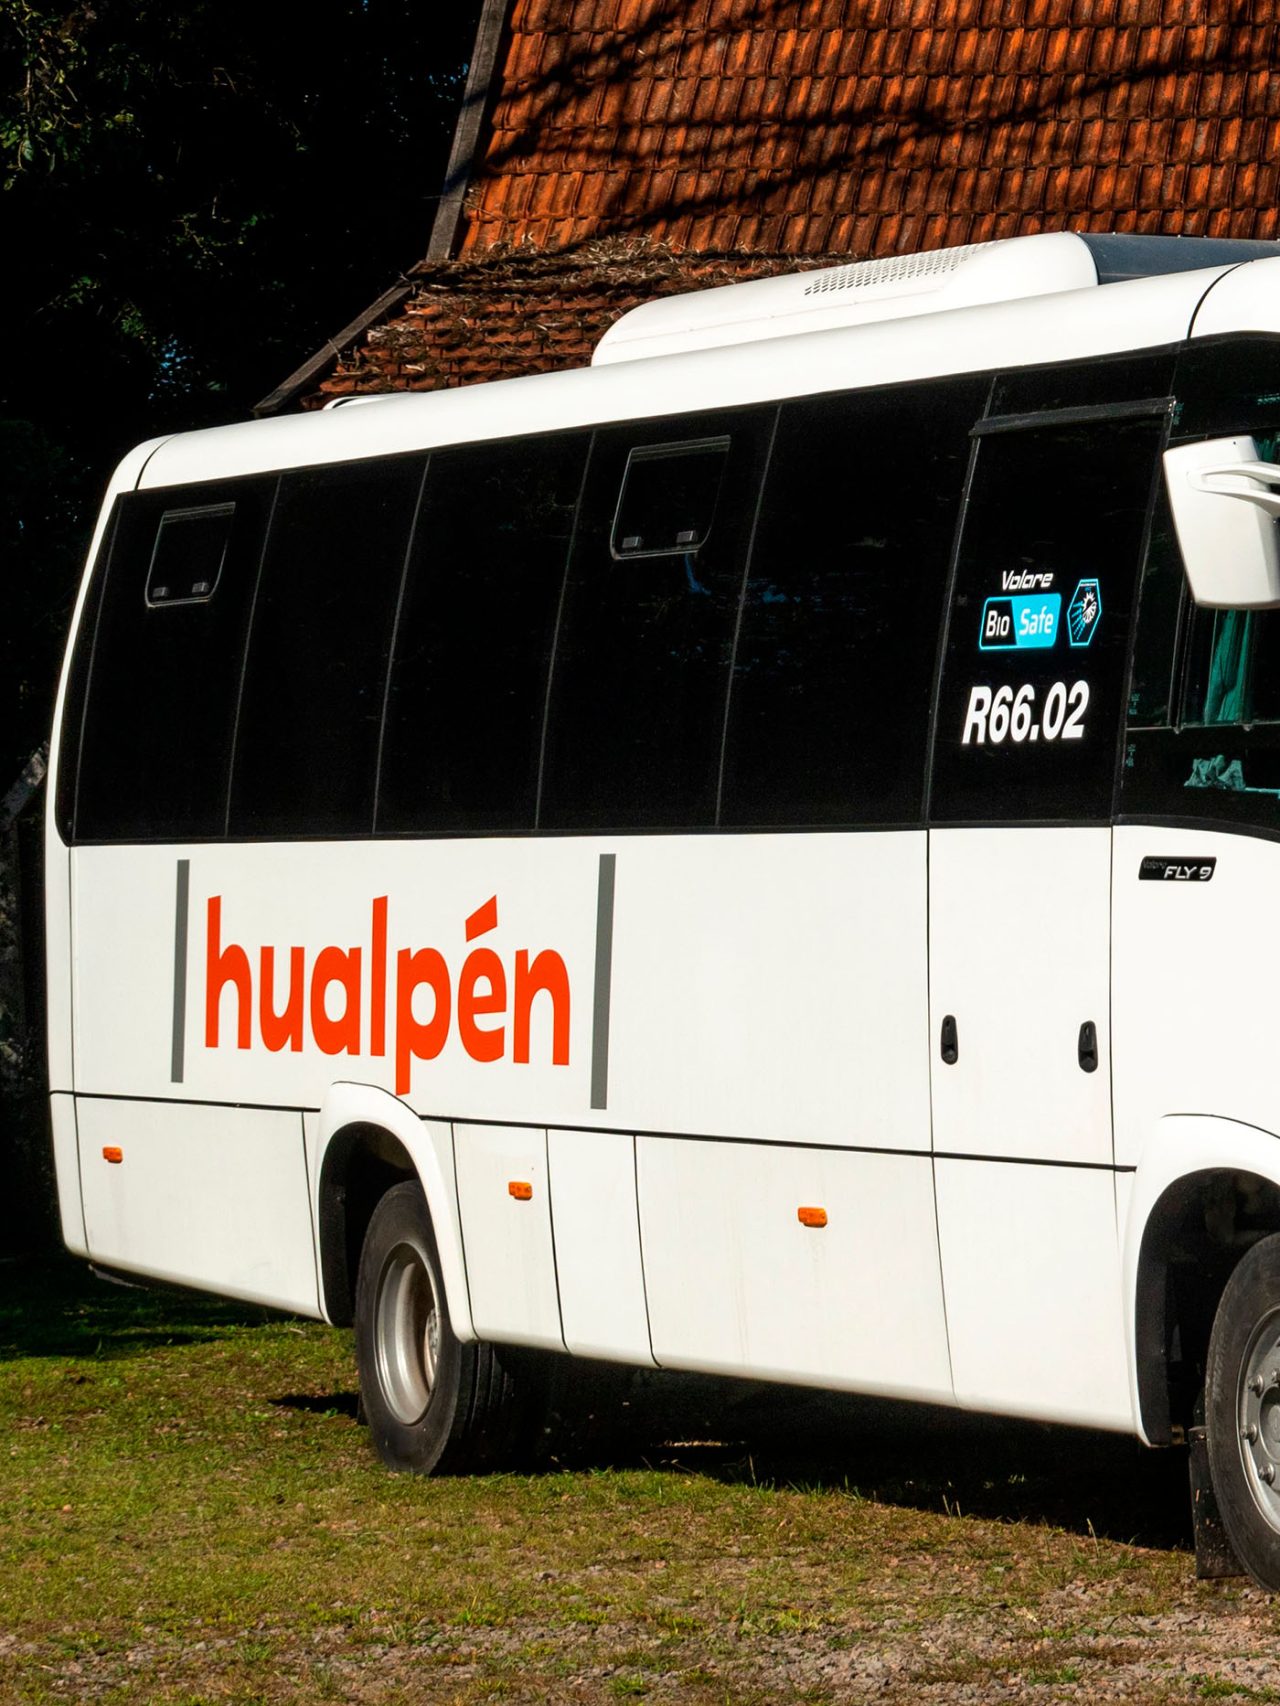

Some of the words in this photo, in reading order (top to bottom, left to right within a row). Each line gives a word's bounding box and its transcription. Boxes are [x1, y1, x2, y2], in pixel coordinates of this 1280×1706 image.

[1002, 569, 1054, 590] Volare
[1019, 605, 1054, 636] Safe
[961, 680, 1089, 744] R66.02
[1163, 865, 1197, 879] FLY
[1199, 866, 1212, 879] 9
[205, 895, 571, 1096] hualpén
